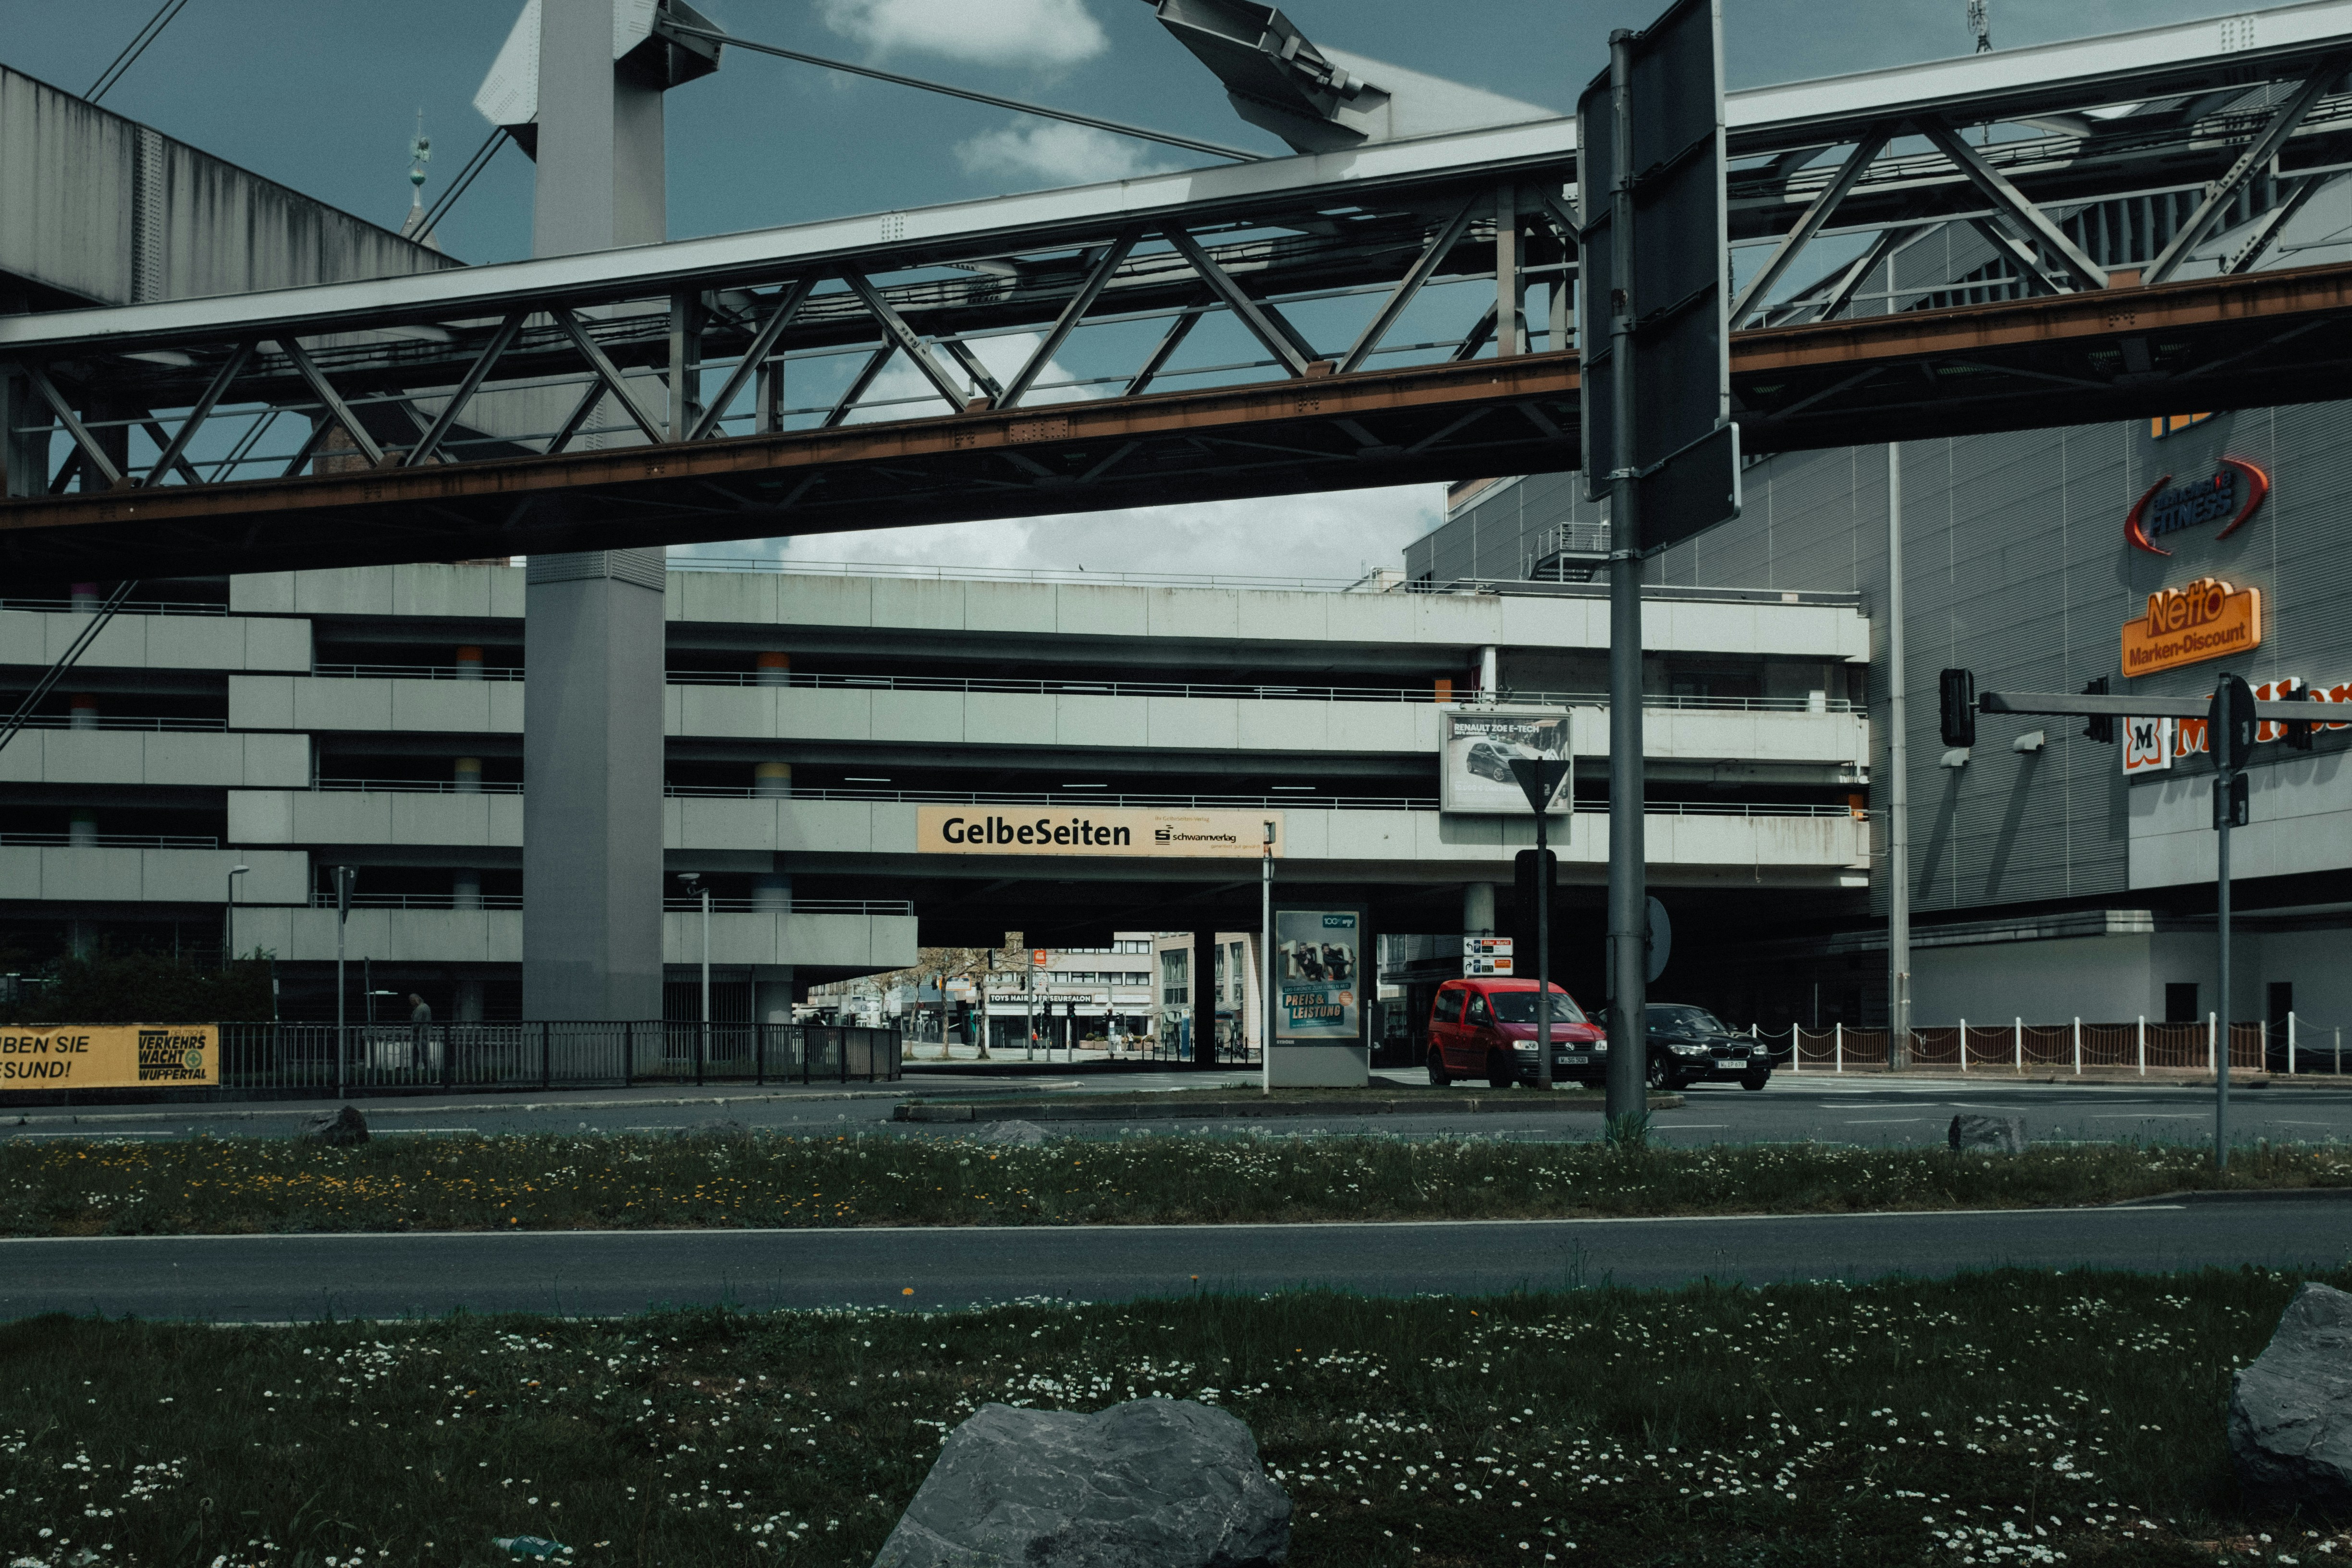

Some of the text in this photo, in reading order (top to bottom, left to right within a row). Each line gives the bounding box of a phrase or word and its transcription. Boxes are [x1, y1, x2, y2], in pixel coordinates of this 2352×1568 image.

[2150, 489, 2232, 538] FITNESS
[2147, 580, 2225, 638] Netto
[2130, 622, 2245, 667] Marken-Discount
[1455, 723, 1490, 732] RENAULT
[1509, 725, 1539, 733] E-TECH
[2135, 723, 2153, 750] M
[943, 816, 1130, 845] GelbeSeiten
[1173, 833, 1236, 843] schwannverlag
[1286, 993, 1324, 1006] PREIS &
[1293, 1005, 1340, 1019] LEISTUNG
[55, 1036, 90, 1053] SIE
[139, 1036, 206, 1049] VERKEHRS
[139, 1050, 185, 1063] WACHT
[0, 1061, 72, 1078] SUND!
[139, 1069, 206, 1080] WUPPERTAL
